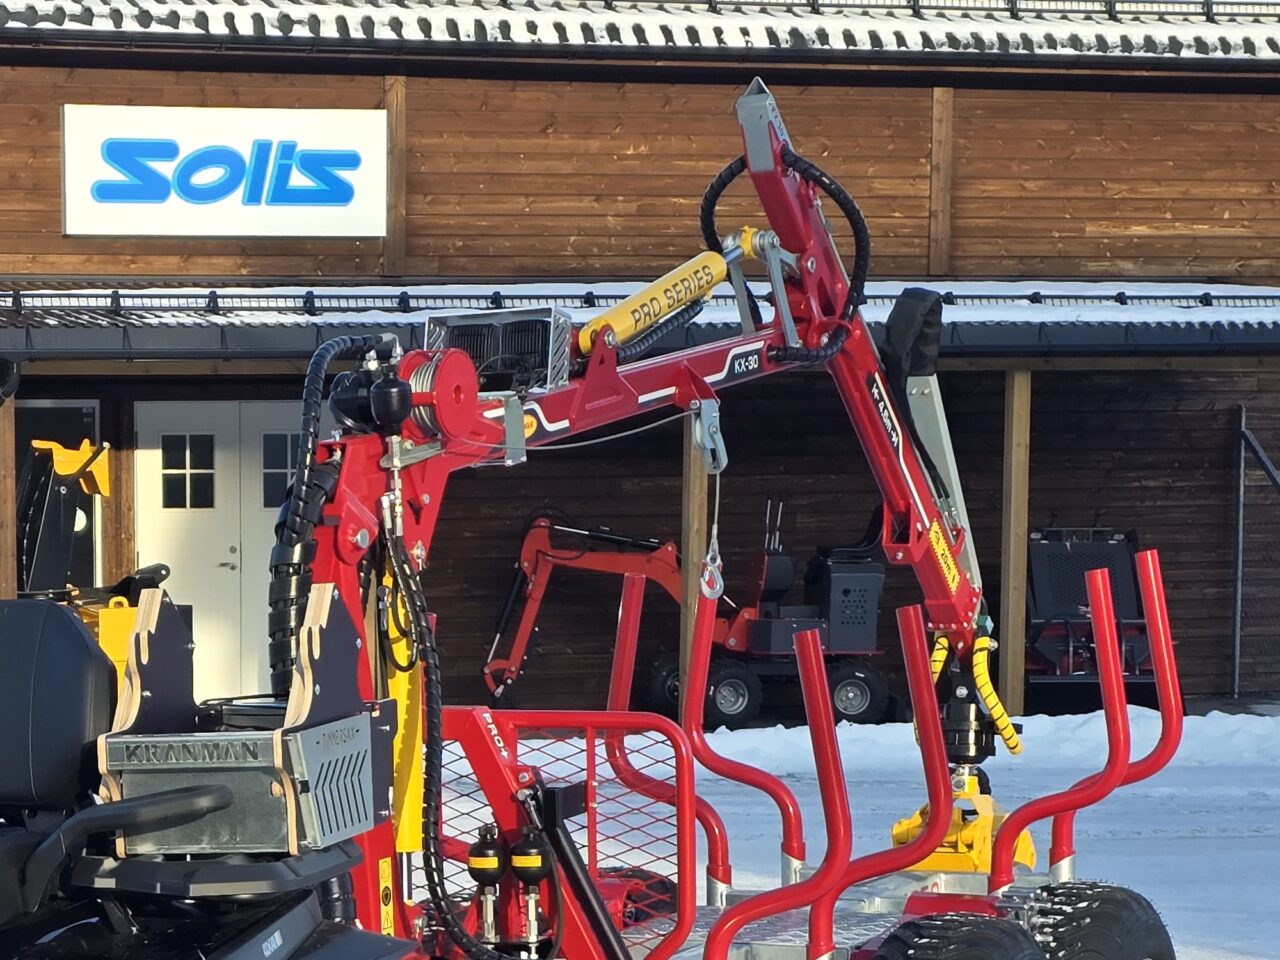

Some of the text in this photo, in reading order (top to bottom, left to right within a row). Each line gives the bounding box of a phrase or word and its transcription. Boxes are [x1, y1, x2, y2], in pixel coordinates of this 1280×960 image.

[91, 138, 361, 206] Solis
[631, 264, 714, 329] PRO SERIES
[734, 354, 758, 373] KX-30
[124, 741, 262, 763] KRANMAN
[482, 712, 509, 759] PRO+
